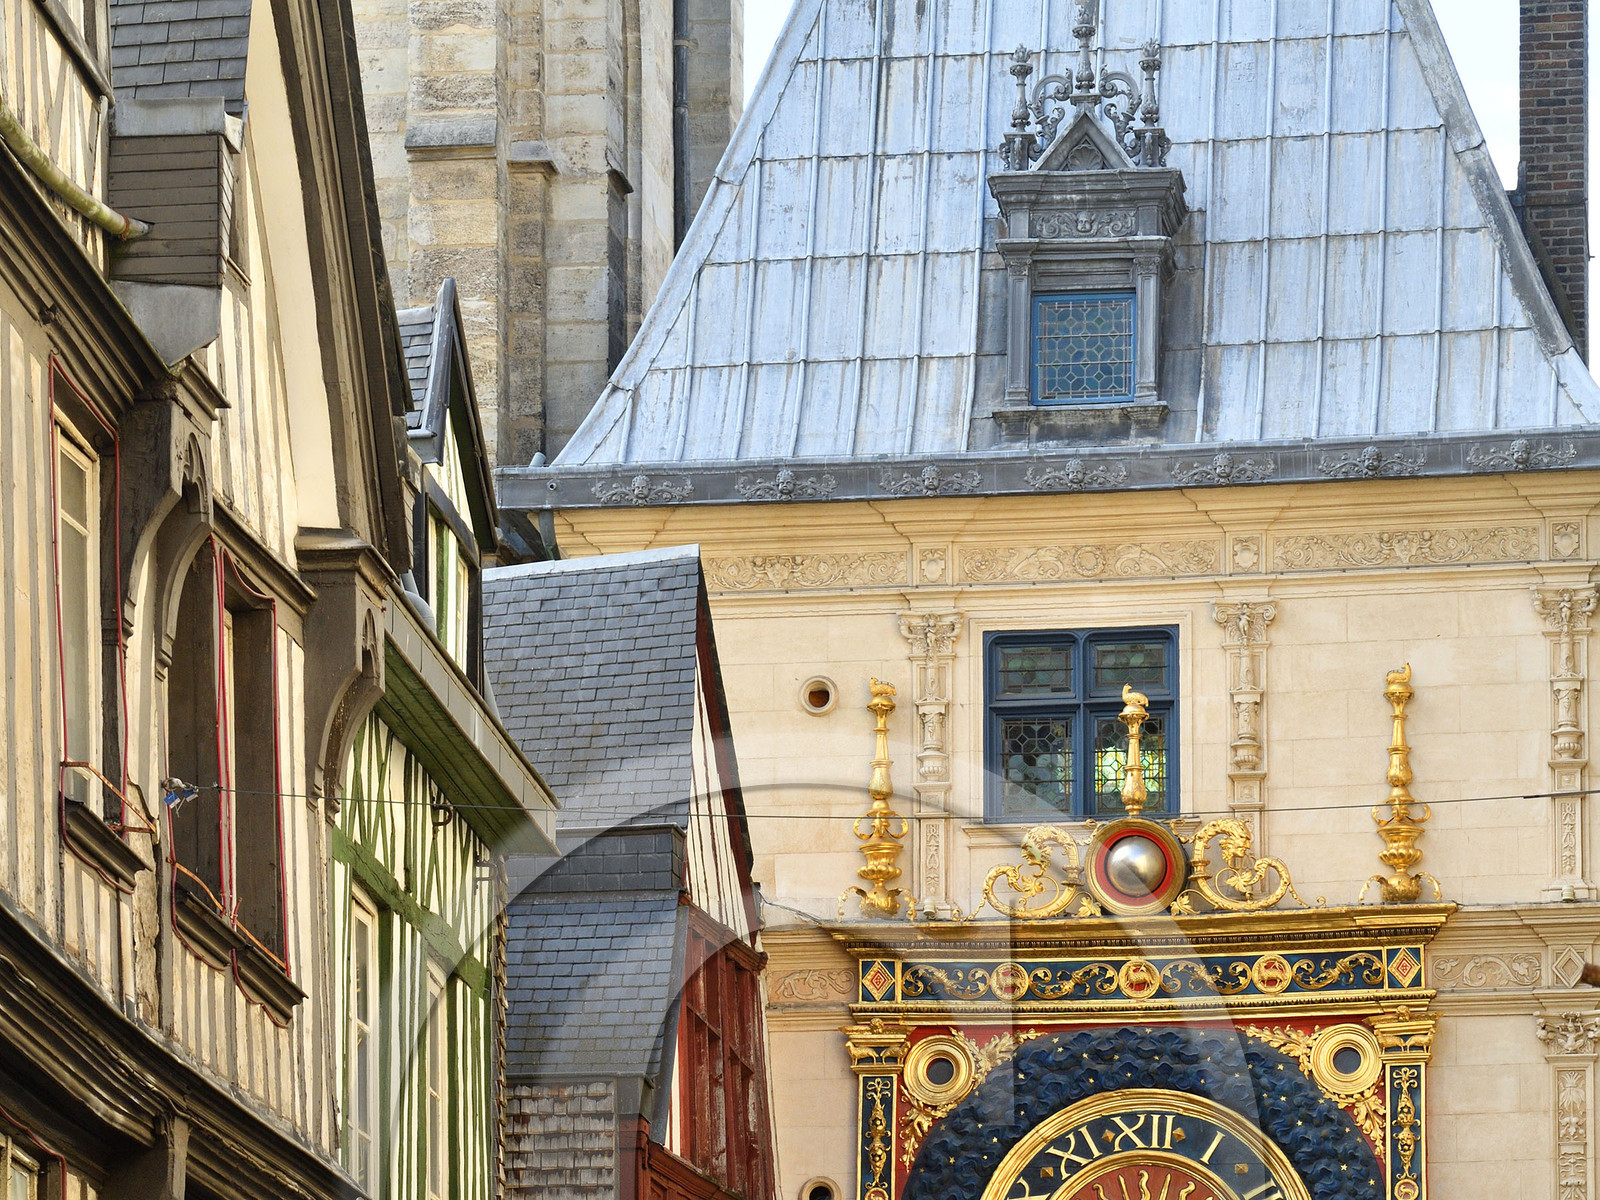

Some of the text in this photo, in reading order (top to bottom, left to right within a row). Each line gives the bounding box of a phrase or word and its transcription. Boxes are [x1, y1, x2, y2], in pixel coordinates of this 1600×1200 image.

[1113, 1114, 1174, 1150] XII
[1200, 1131, 1225, 1164] I
[1046, 1125, 1103, 1179] XI
